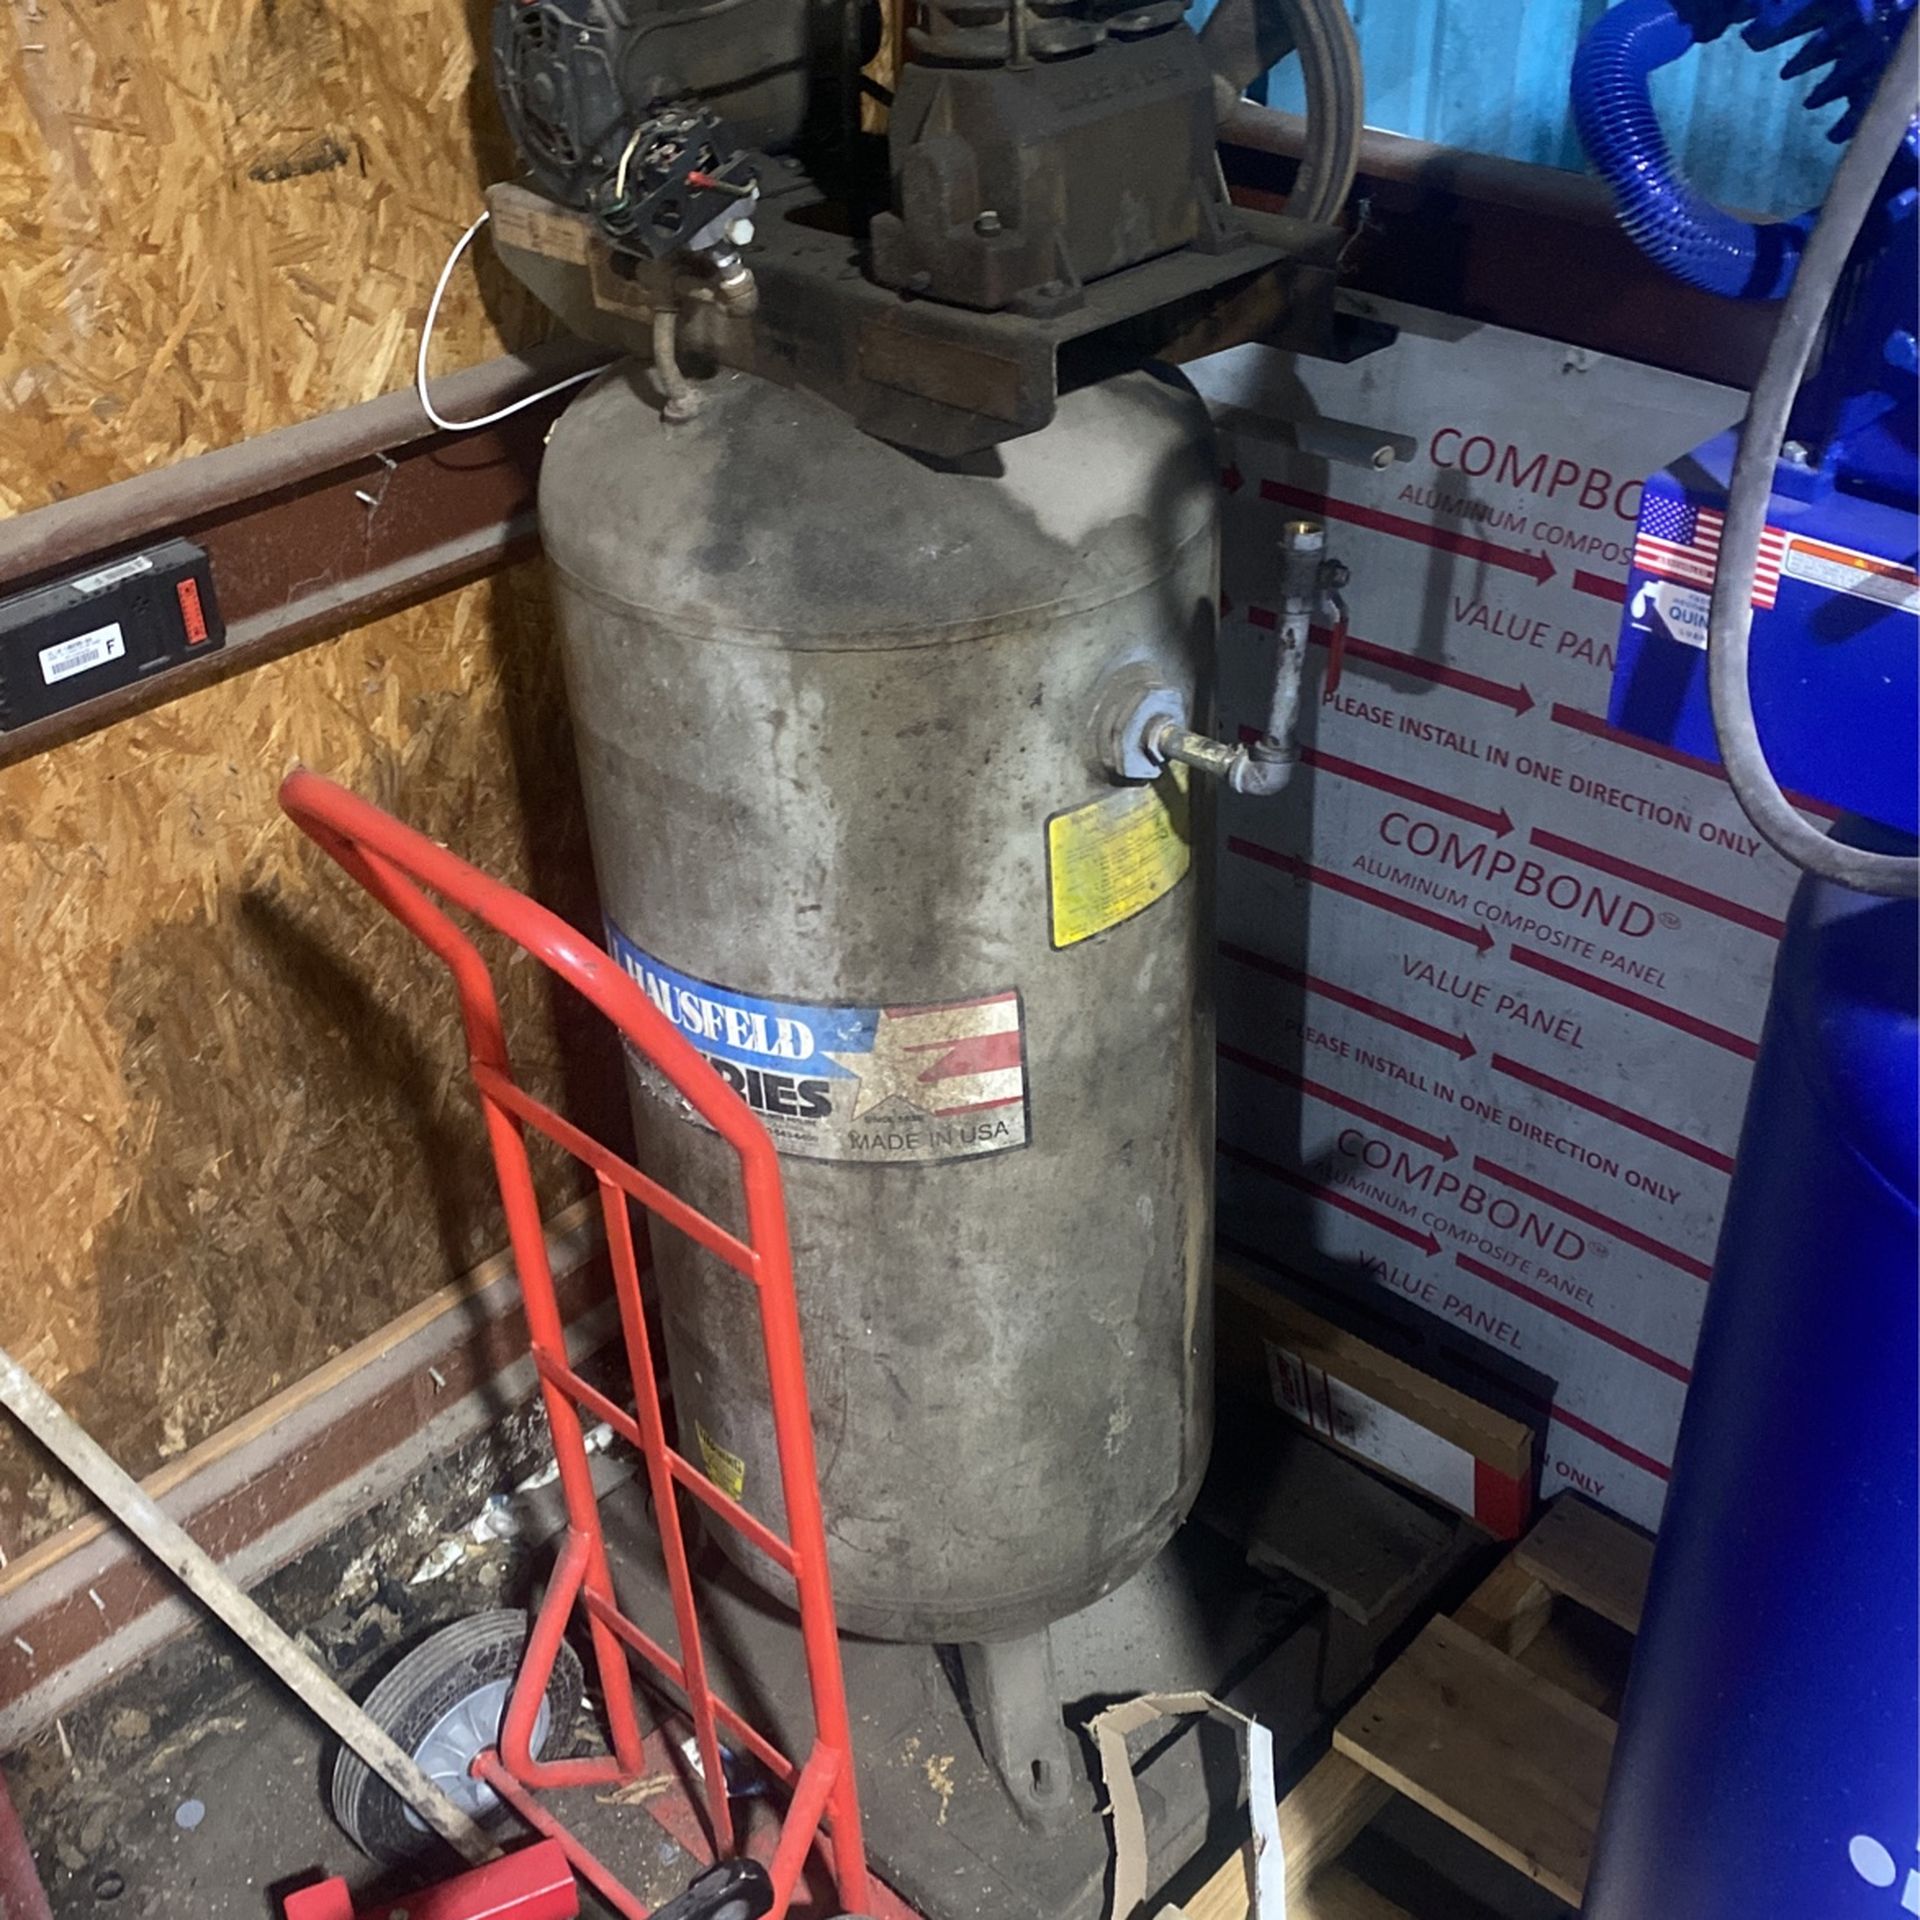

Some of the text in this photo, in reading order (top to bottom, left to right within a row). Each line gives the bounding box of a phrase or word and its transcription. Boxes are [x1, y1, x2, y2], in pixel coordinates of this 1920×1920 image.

[1429, 428, 1644, 521] COMPBO
[1397, 484, 1527, 534] ALUMINUM
[1532, 521, 1635, 566] COMPOS
[106, 638, 116, 655] F
[1453, 597, 1616, 671] VALUE PAN
[1669, 606, 1709, 628] QUIN
[1322, 692, 1761, 858] PLEASE INSTALL IN ONE DIRECTION ONLY
[1352, 855, 1668, 989] ALUMINUM COMPOSITE PANEL
[1379, 812, 1656, 938] COMPBOND
[1403, 954, 1584, 1050] VALUE PANEL
[700, 1053, 833, 1119] RIES
[1355, 1048, 1428, 1092] INSTALL
[1433, 1081, 1455, 1103] IN
[1460, 1095, 1503, 1125] ONE
[1508, 1115, 1619, 1179] DIRECTION
[1624, 1170, 1681, 1204] ONLY
[851, 1120, 1009, 1150] MADE IN USA
[1338, 1128, 1586, 1261] COMPBOND
[1359, 1250, 1522, 1350] VALUE PANEL
[1422, 1212, 1532, 1274] COMPOSITE
[1536, 1267, 1595, 1308] PANEL
[1556, 1461, 1605, 1496] ONLY
